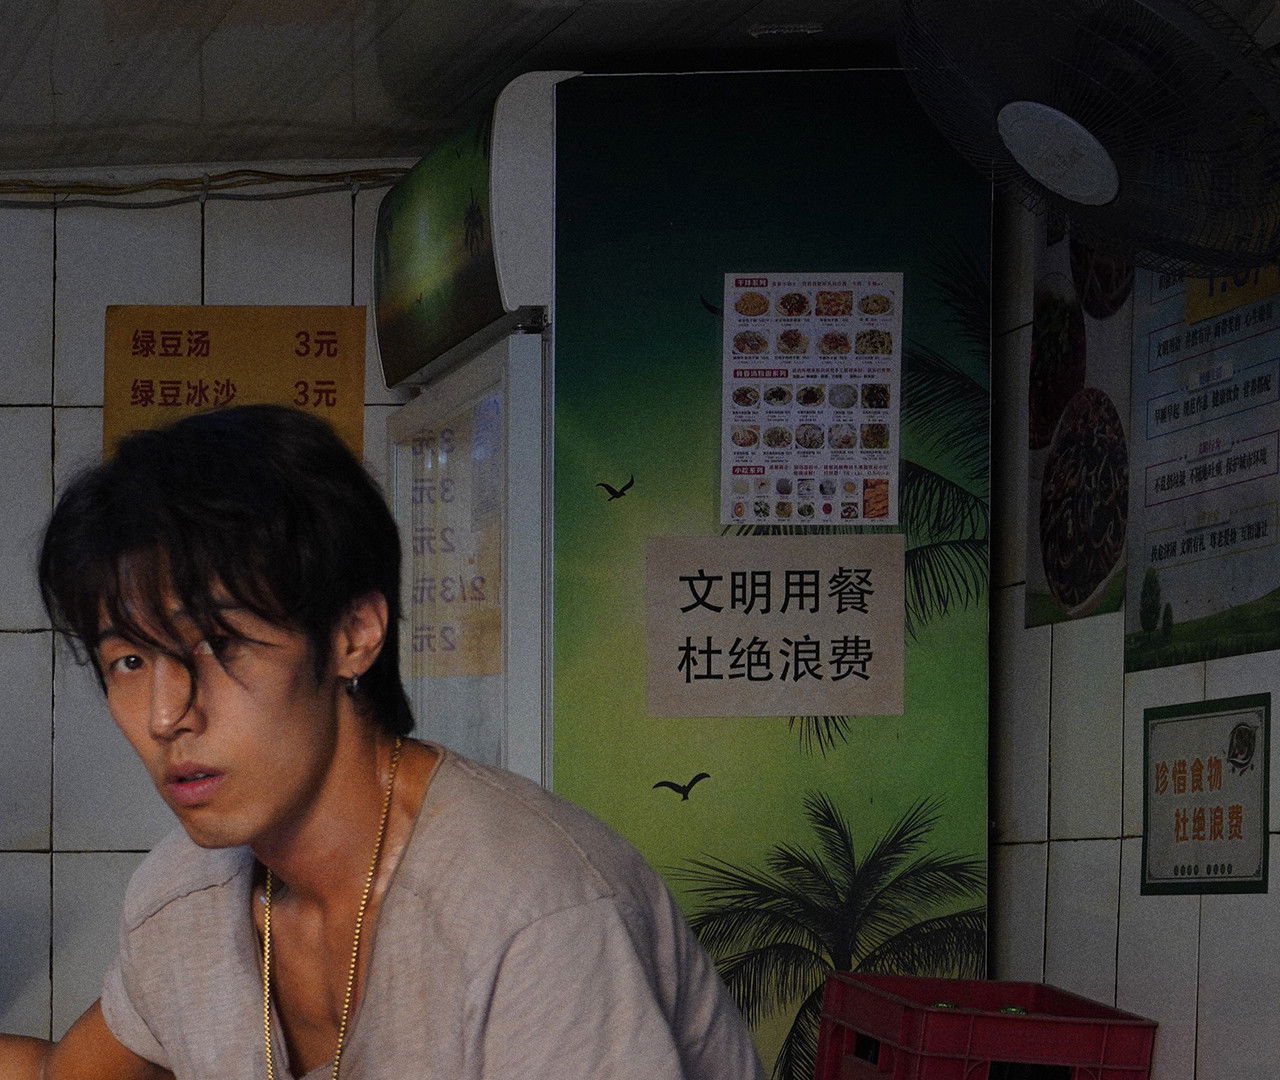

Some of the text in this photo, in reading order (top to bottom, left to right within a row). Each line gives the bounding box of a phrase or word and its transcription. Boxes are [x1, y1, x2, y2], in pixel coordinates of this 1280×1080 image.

[131, 329, 339, 360] 绿豆汤 3元
[130, 379, 338, 409] 绿豆冰沙 3元
[678, 566, 876, 616] 文明用餐
[677, 633, 875, 683] 杜绝浪费
[1155, 756, 1223, 796] 珍惜食物
[1174, 804, 1244, 843] 杜绝浪费
